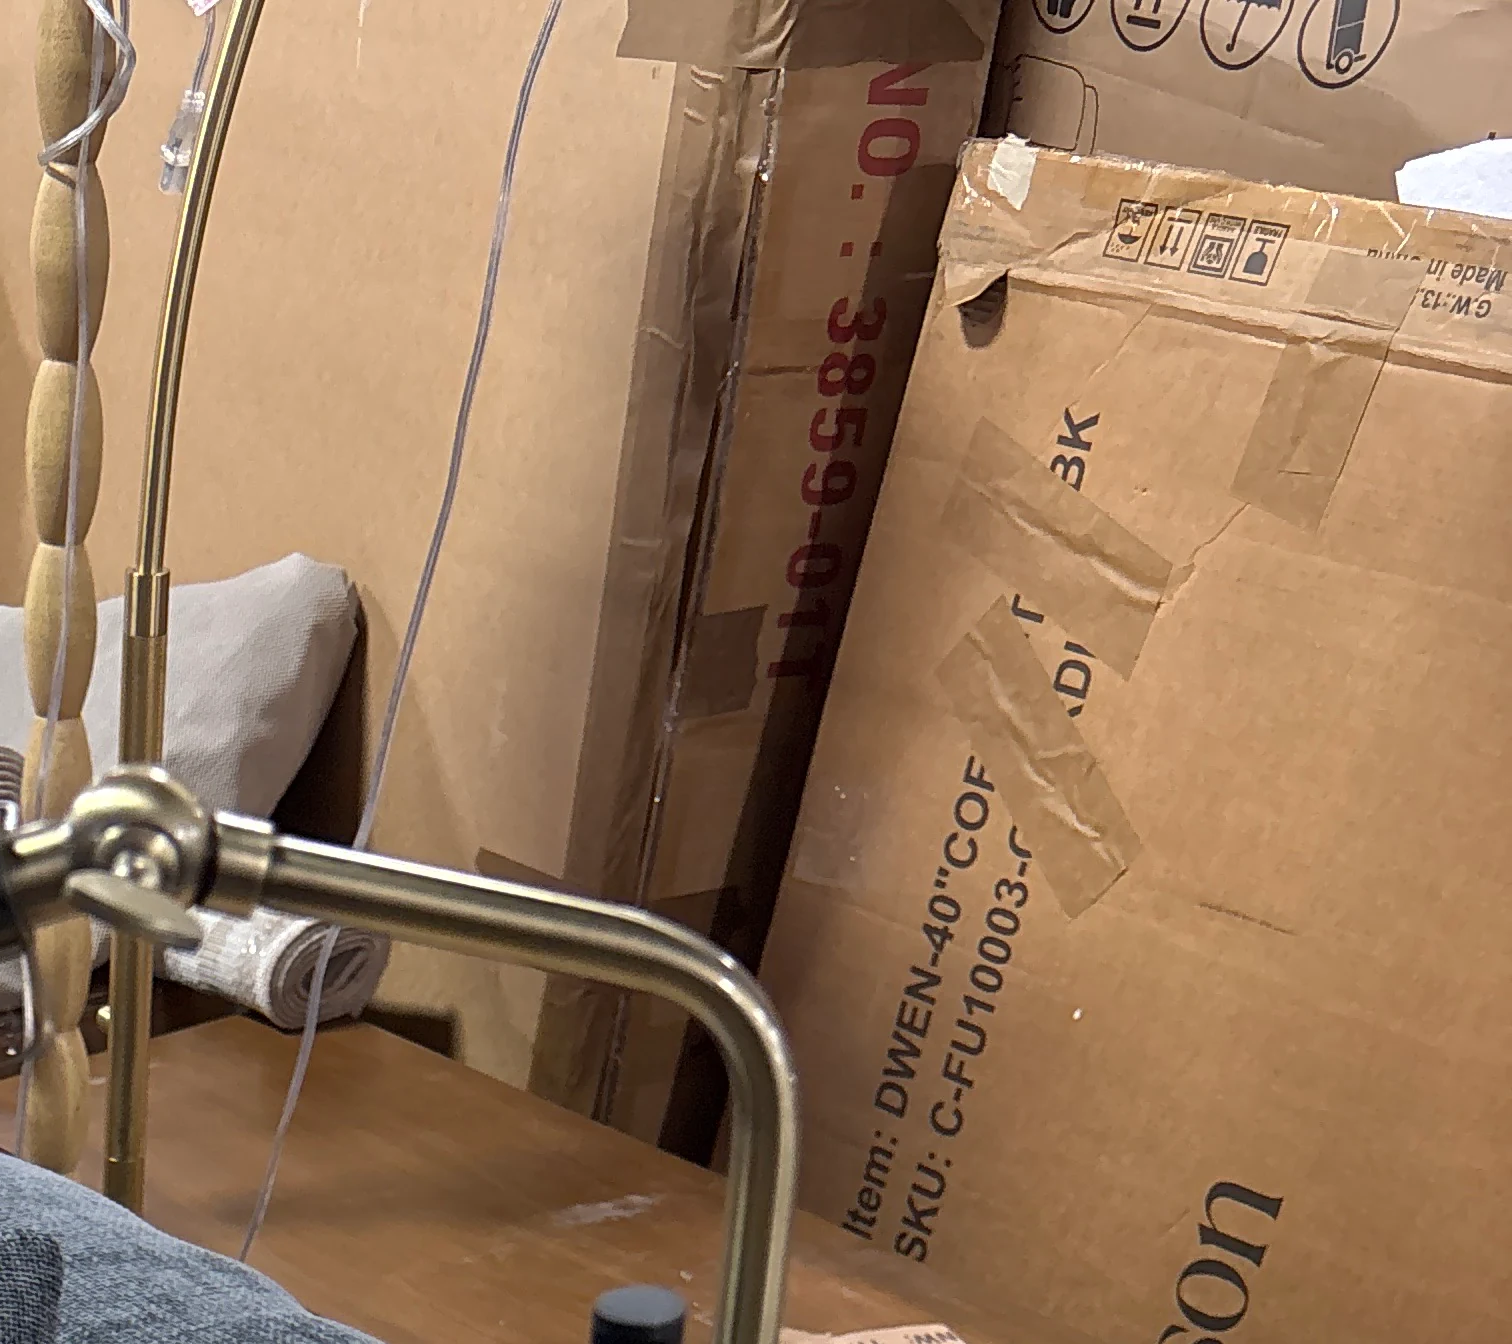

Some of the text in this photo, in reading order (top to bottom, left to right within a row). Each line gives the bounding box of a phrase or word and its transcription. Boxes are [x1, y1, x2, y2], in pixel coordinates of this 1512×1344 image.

[1426, 258, 1508, 292] Made in
[842, 1130, 898, 1240] Item:
[895, 1151, 952, 1264] SKU:
